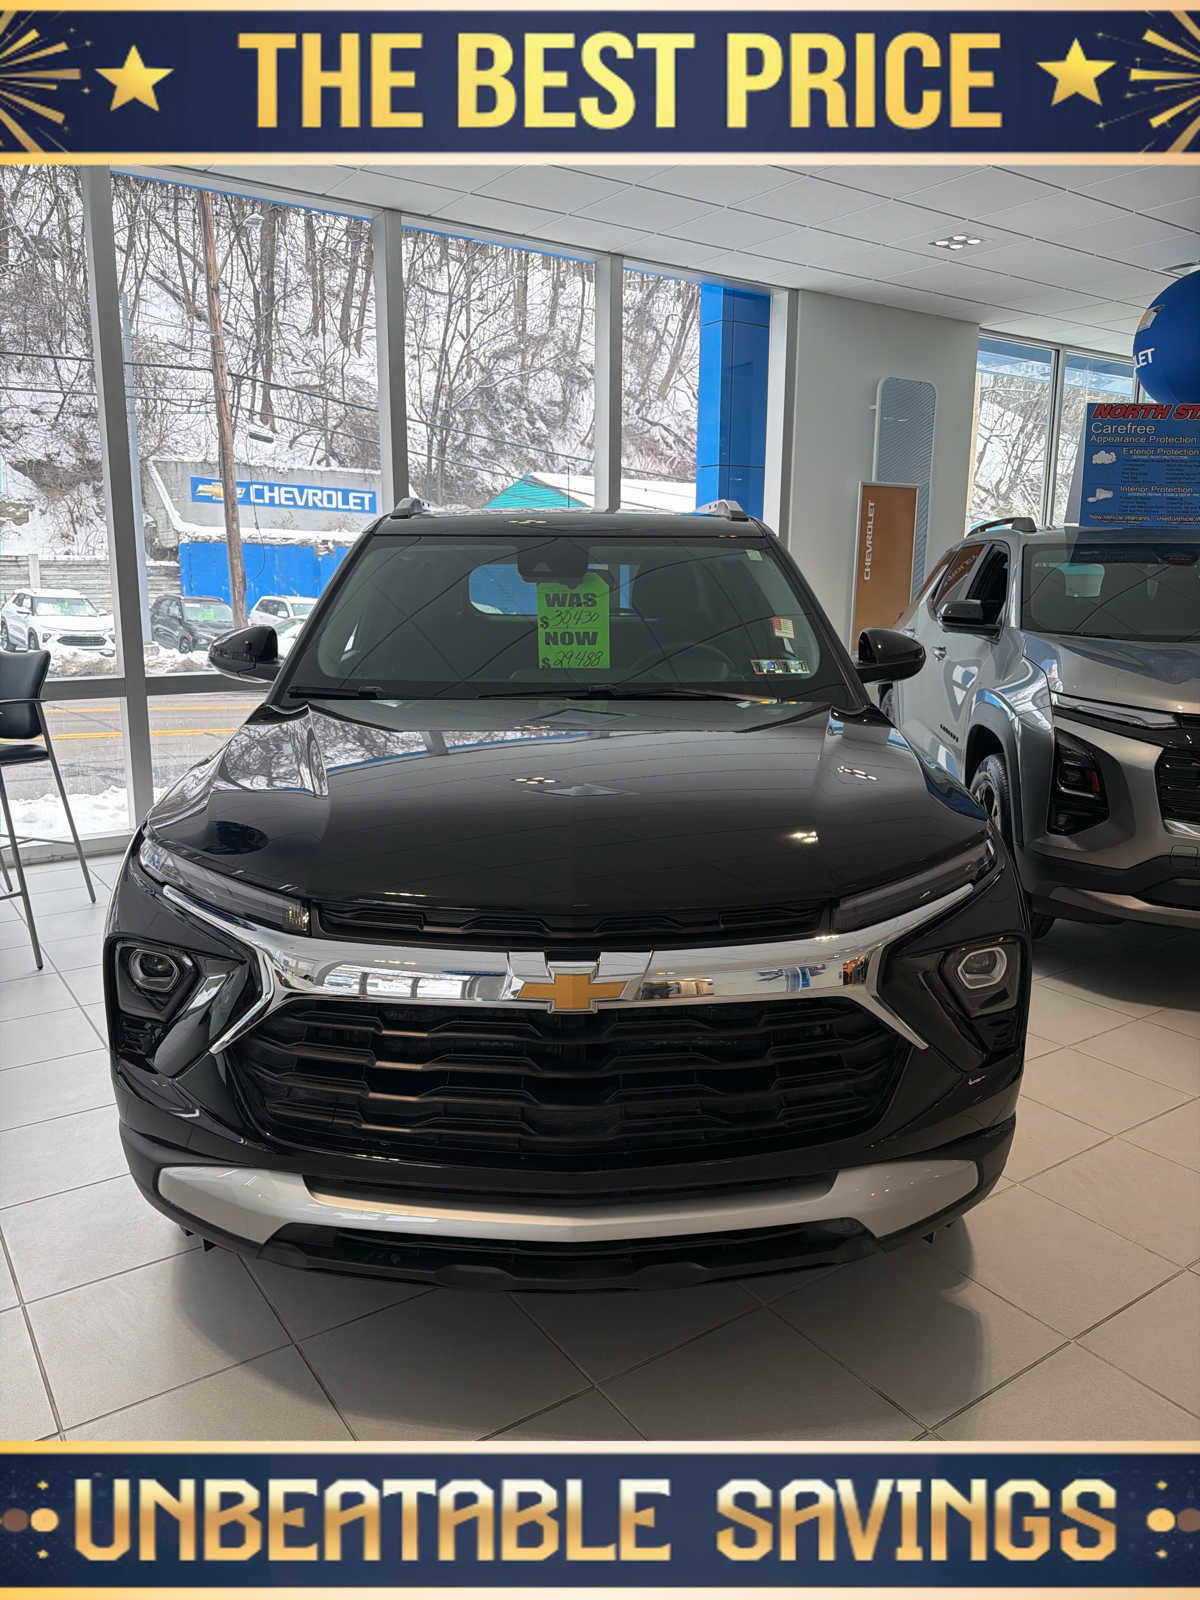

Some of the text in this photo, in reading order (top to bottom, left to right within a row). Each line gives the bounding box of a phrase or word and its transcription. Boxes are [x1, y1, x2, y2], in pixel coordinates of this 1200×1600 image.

[1092, 403, 1200, 419] NORTH ST
[1091, 422, 1155, 434] Carefree
[1091, 434, 1197, 444] Appearance Protection
[1123, 447, 1154, 455] Exterior
[250, 484, 373, 511] CHEVROLET
[864, 499, 875, 580] CHEVROLET
[544, 592, 598, 608] WAS
[544, 631, 599, 646] NOW
